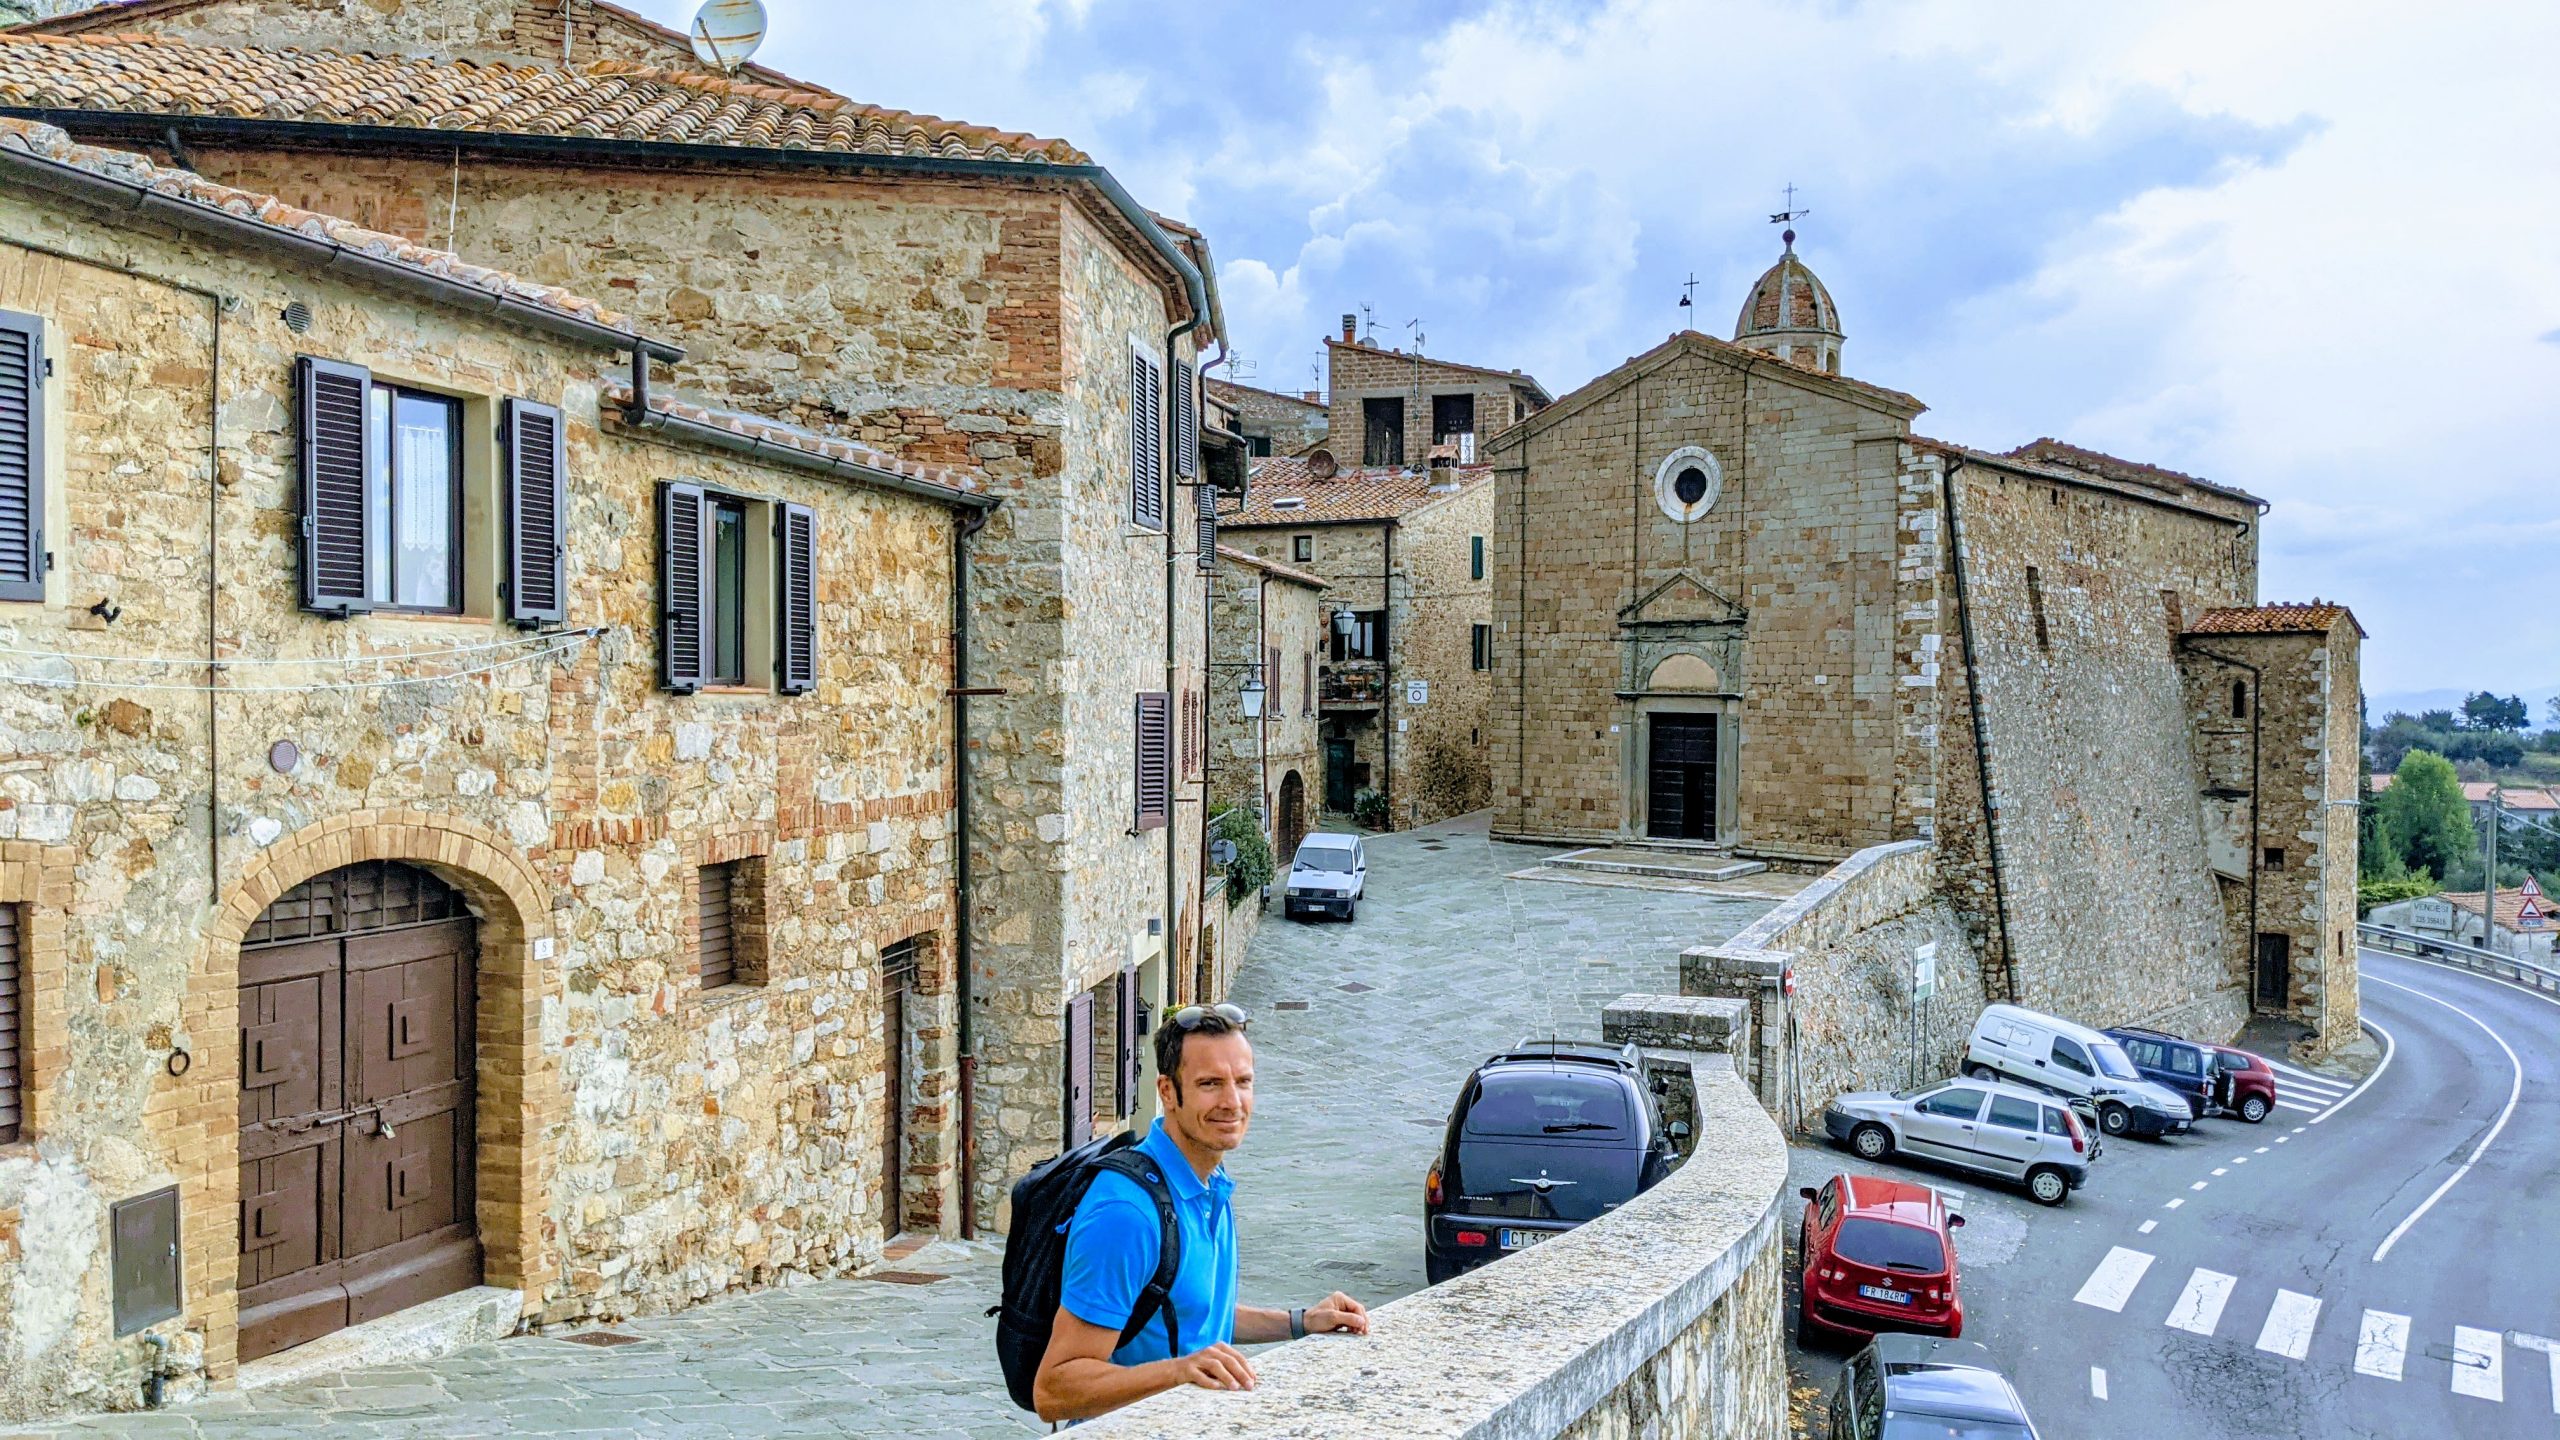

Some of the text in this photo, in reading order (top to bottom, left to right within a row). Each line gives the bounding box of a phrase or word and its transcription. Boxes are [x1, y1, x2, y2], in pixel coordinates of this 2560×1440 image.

[2413, 902, 2449, 913] VENDESI
[1511, 1231, 1527, 1246] CT
[1865, 1286, 1877, 1295] FR
[1880, 1289, 1906, 1301] 184RM
